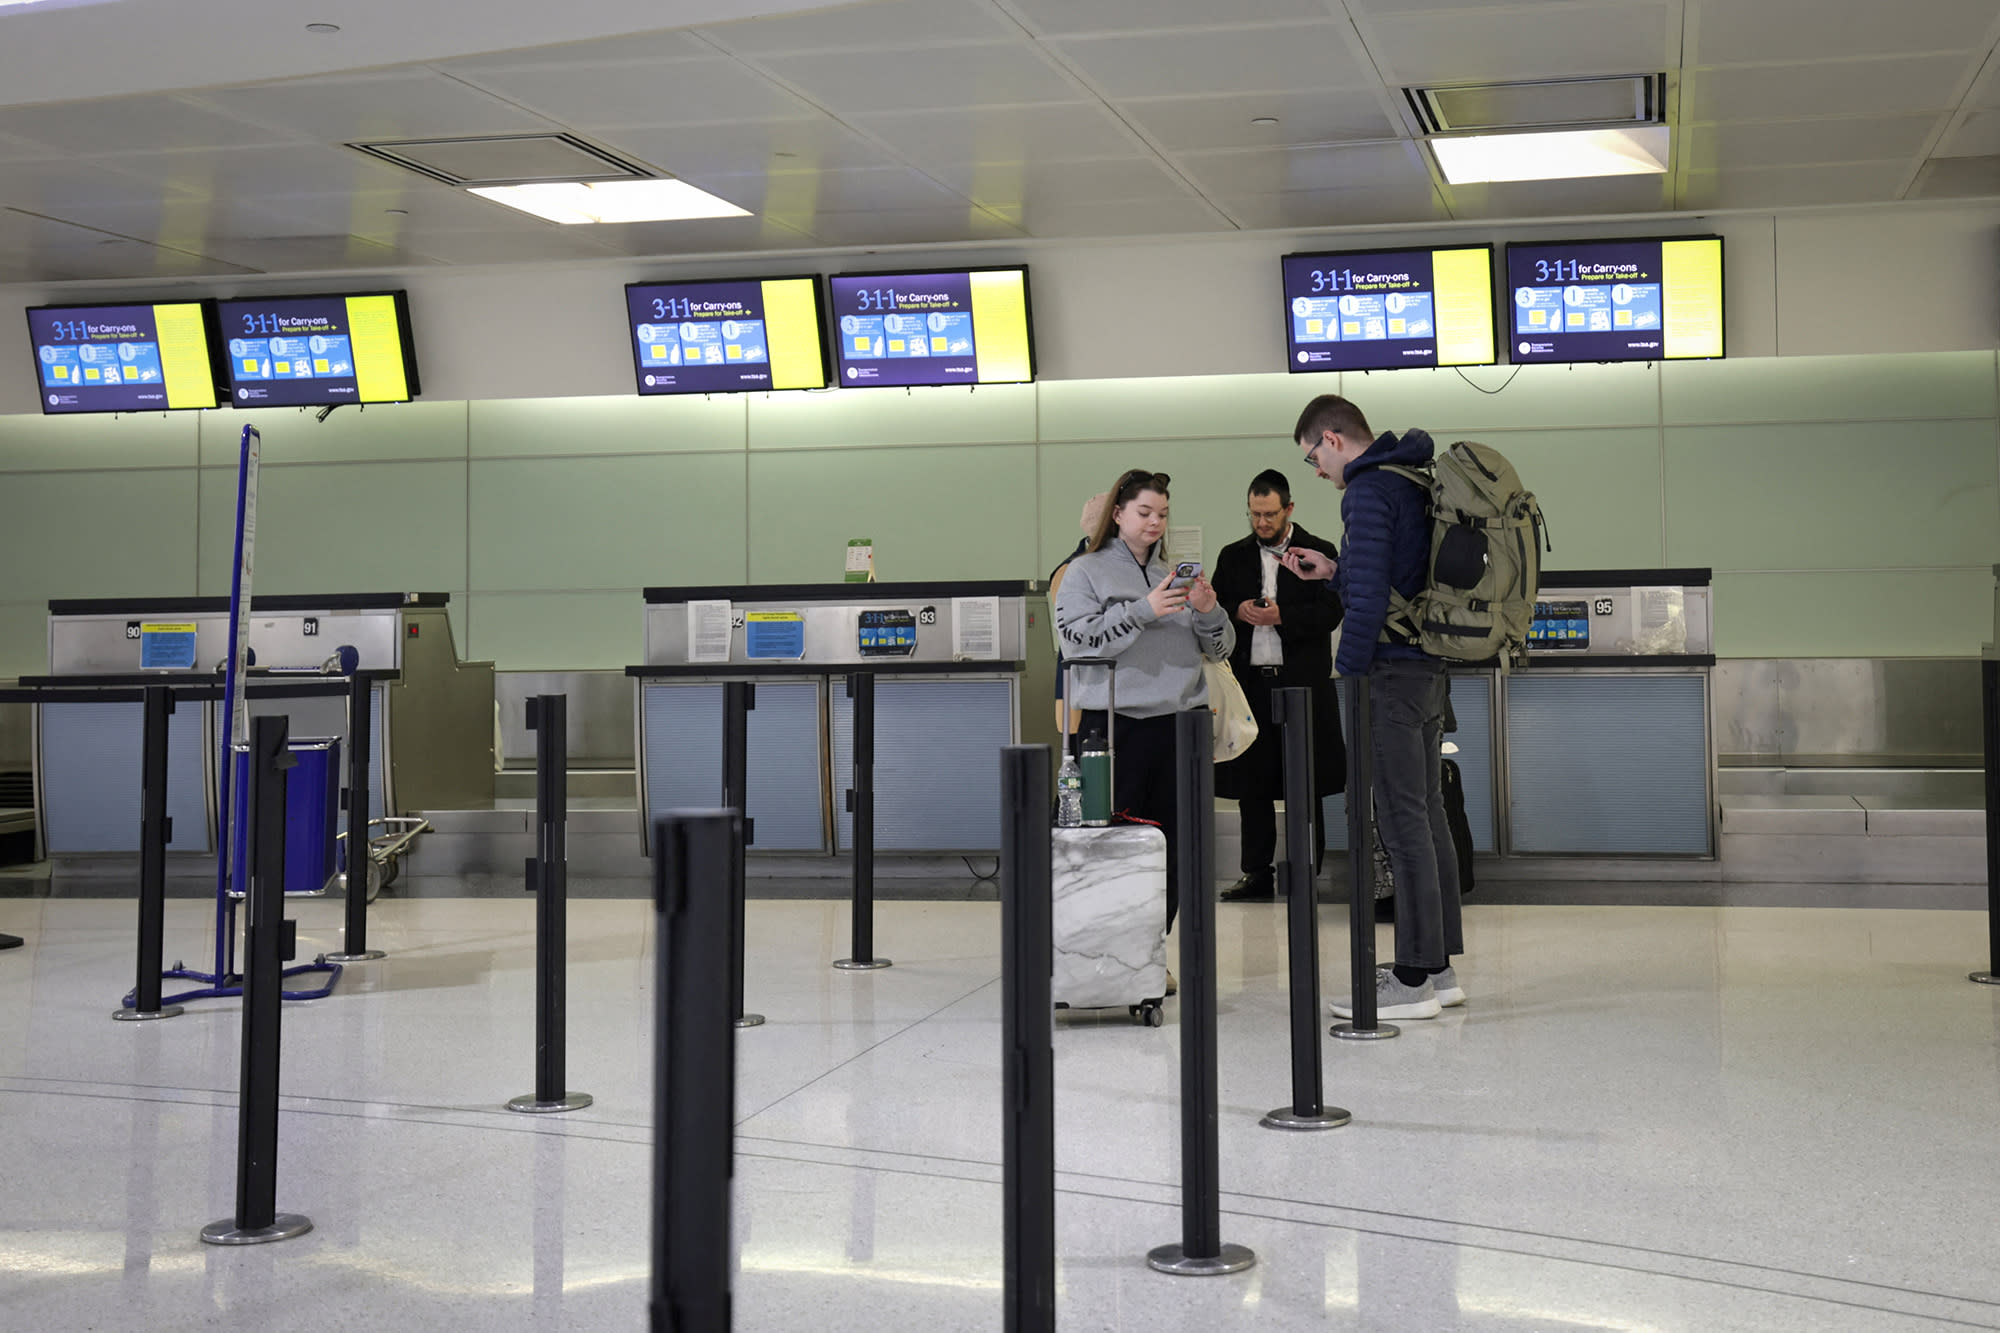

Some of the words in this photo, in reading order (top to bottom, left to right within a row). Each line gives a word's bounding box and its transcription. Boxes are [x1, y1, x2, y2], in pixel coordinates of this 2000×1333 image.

[1536, 259, 1579, 282] 3-1-1
[1579, 265, 1591, 273] for
[1594, 264, 1637, 273] Carry-ons
[1311, 269, 1353, 292] 3-1-1
[1352, 274, 1365, 283] for
[1367, 273, 1409, 283] Carry-ons
[653, 298, 691, 319] 3-1-1
[690, 303, 702, 311] for
[703, 302, 741, 311] Carry-ons
[857, 289, 897, 310] 3-1-1
[896, 294, 908, 302] for
[910, 293, 949, 302] Carry-ons
[52, 321, 89, 340] 3-1-1
[88, 325, 98, 333] for
[100, 325, 136, 334] Carry-ons
[243, 313, 280, 333] 3-1-1
[279, 318, 289, 326] for
[291, 317, 328, 326] Carry-ons
[1597, 602, 1612, 613] 95
[921, 612, 934, 623] 93
[128, 627, 139, 637] 90
[305, 622, 316, 633] 91
